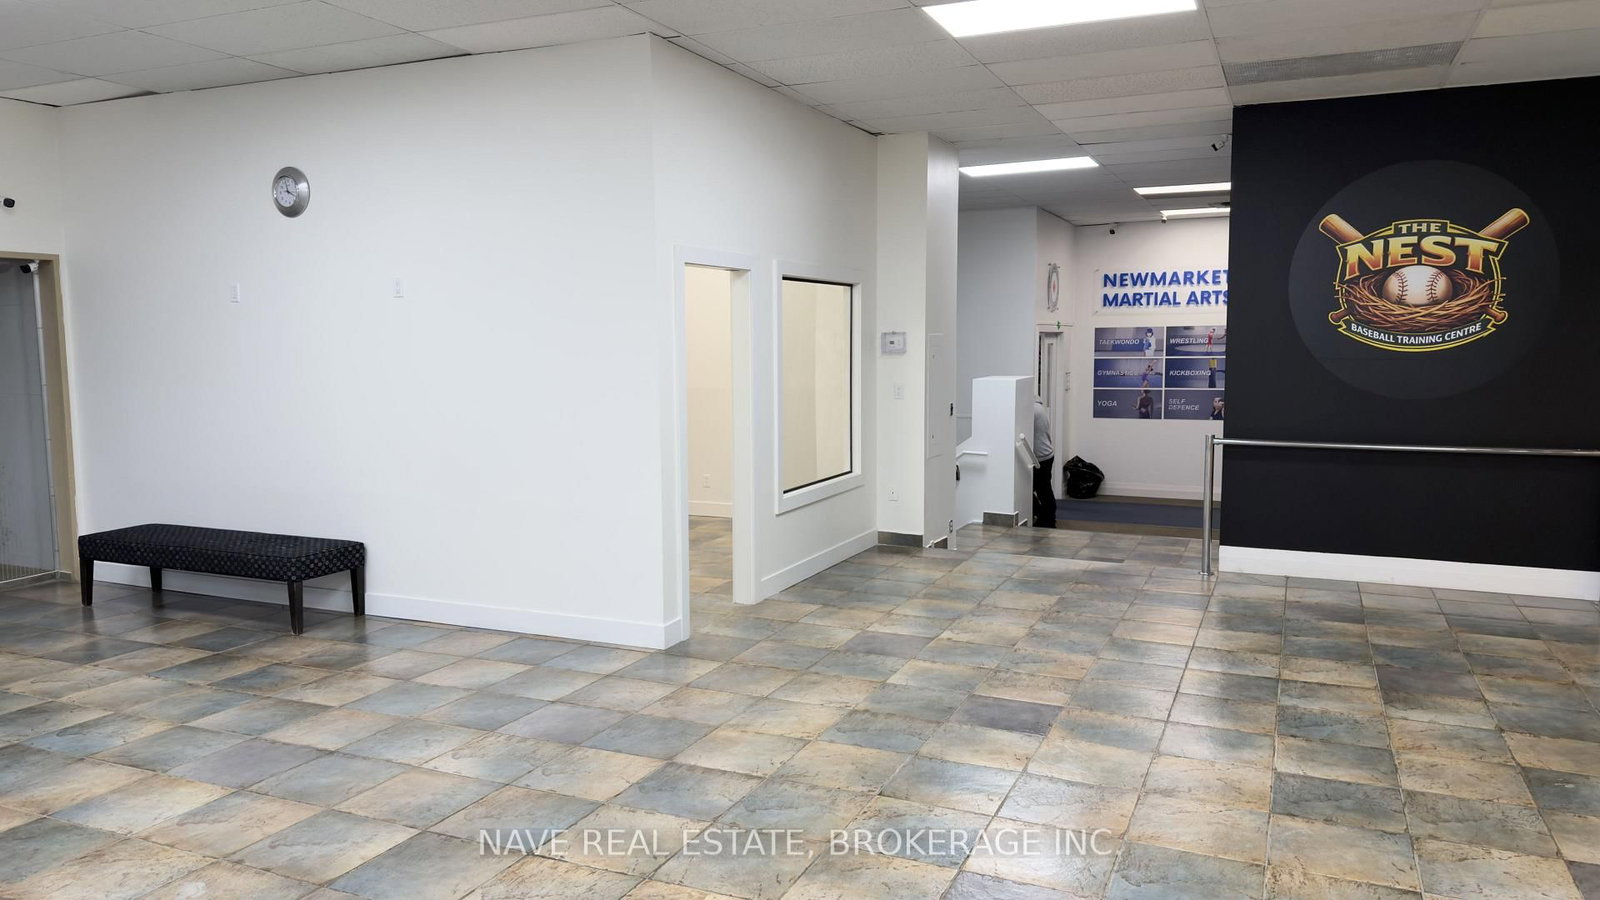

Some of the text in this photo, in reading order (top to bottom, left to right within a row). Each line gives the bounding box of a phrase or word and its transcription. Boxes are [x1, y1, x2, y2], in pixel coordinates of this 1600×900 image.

[1398, 223, 1442, 234] THE
[1344, 235, 1499, 281] NEST
[1103, 290, 1228, 307] MARTIAL ARTS
[1351, 322, 1482, 345] BASEBALL TRAINING CENTRE
